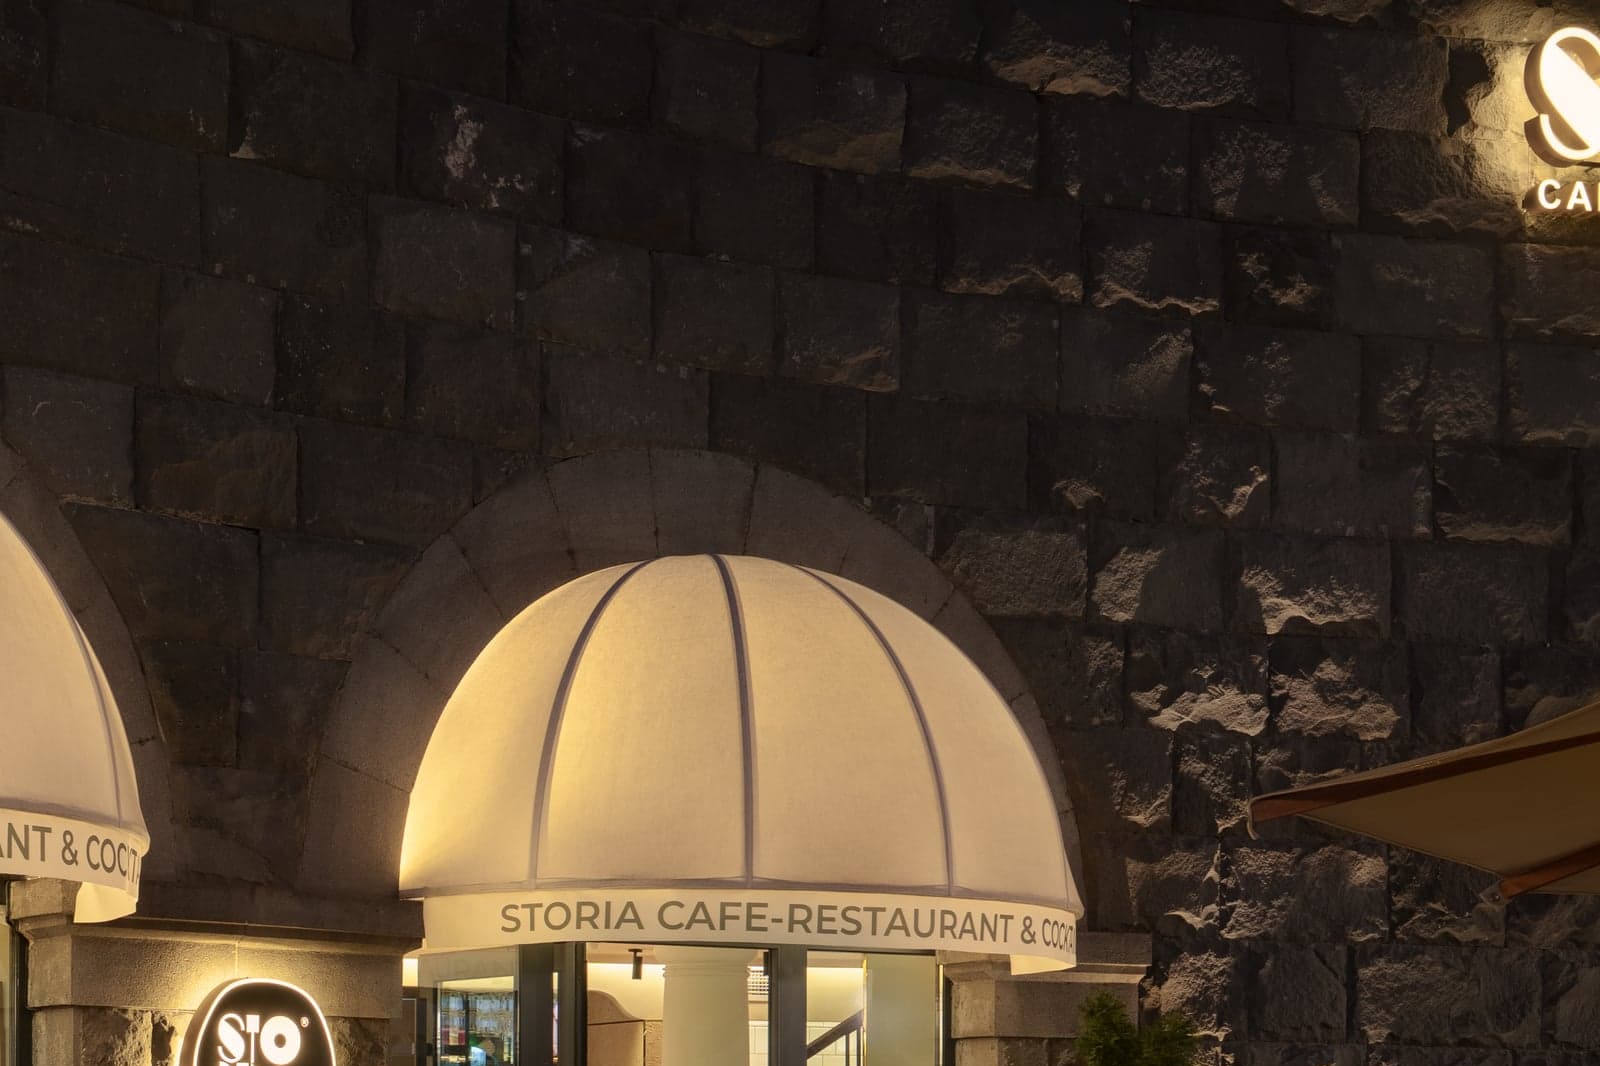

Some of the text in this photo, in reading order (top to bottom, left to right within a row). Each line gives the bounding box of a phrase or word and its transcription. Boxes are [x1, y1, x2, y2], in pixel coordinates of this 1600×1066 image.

[1537, 178, 1600, 212] CA
[61, 829, 79, 867] &
[500, 901, 645, 933] STORIA
[657, 900, 1015, 943] CAFE-RESTAURANT
[1020, 915, 1037, 945] &
